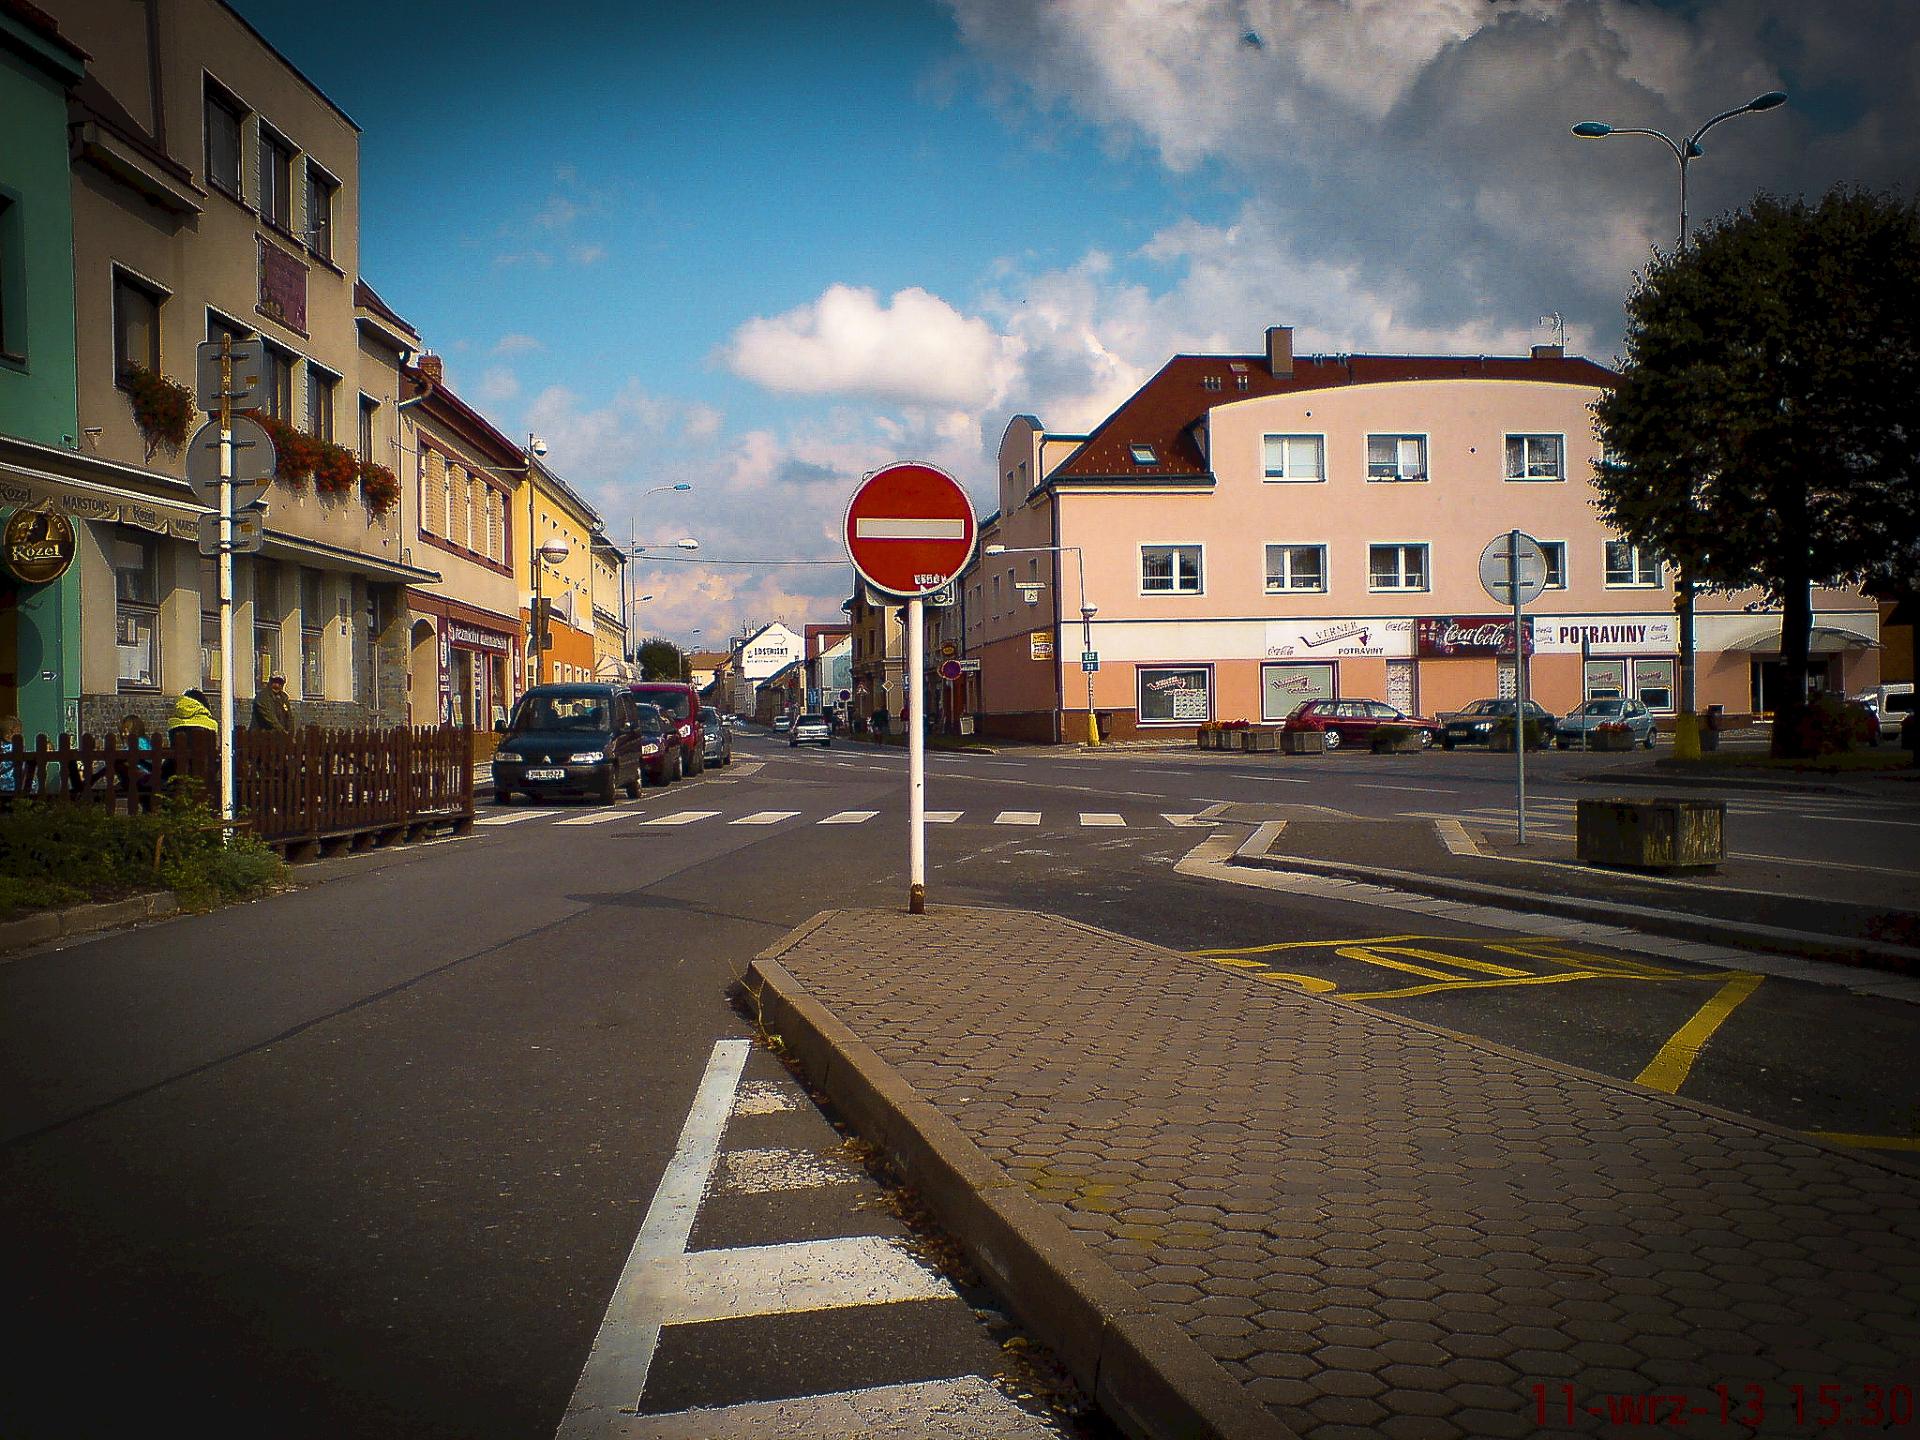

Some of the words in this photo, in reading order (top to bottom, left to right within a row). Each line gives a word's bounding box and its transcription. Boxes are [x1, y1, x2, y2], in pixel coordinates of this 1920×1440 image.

[13, 544, 64, 562] Kozel
[1315, 621, 1359, 640] VERNER
[1559, 625, 1647, 644] POTRAVINY
[1338, 647, 1384, 655] POTRAVINY
